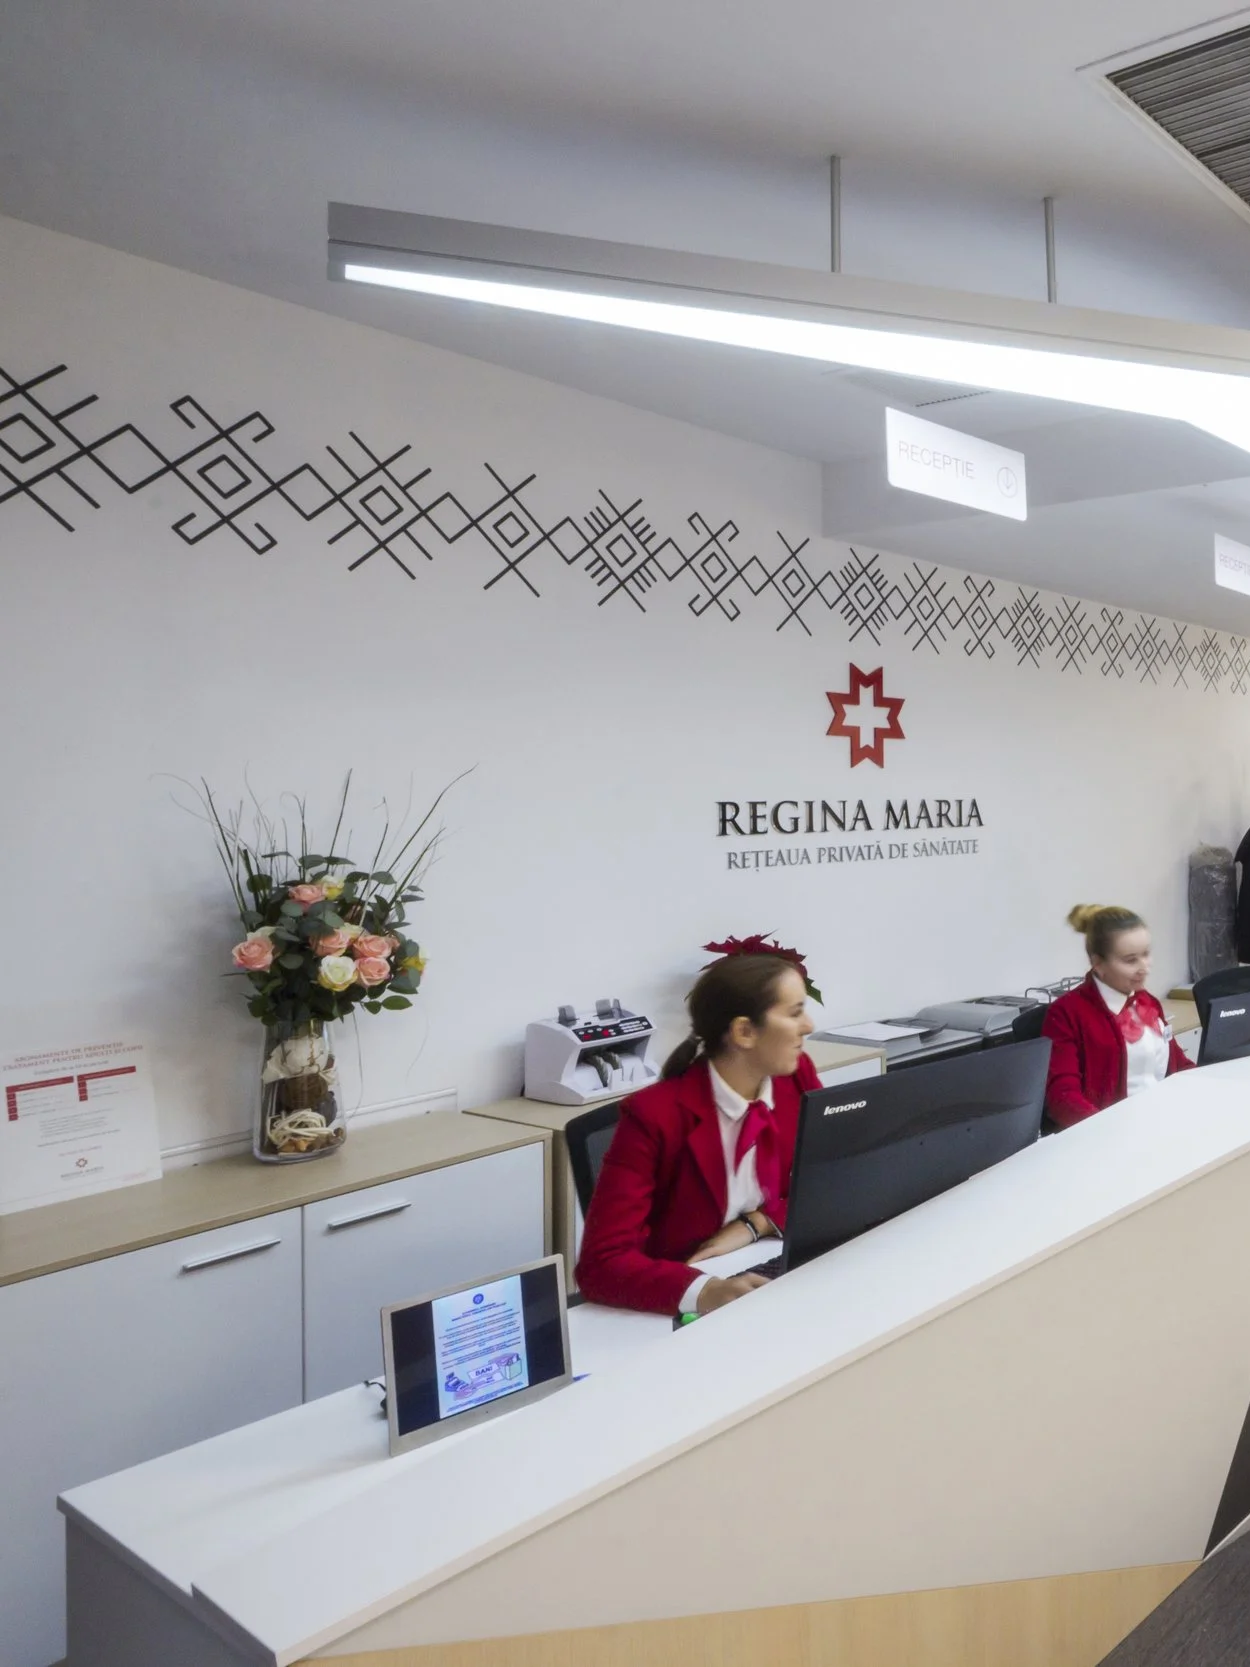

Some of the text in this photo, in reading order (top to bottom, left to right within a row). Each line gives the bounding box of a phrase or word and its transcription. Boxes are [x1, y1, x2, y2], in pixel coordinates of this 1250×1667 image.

[897, 440, 976, 479] RECEPTIE
[715, 798, 984, 837] REGINA MARIA
[888, 842, 909, 860] DE
[1219, 1008, 1246, 1018] lenovo
[823, 1100, 867, 1116] lenovo
